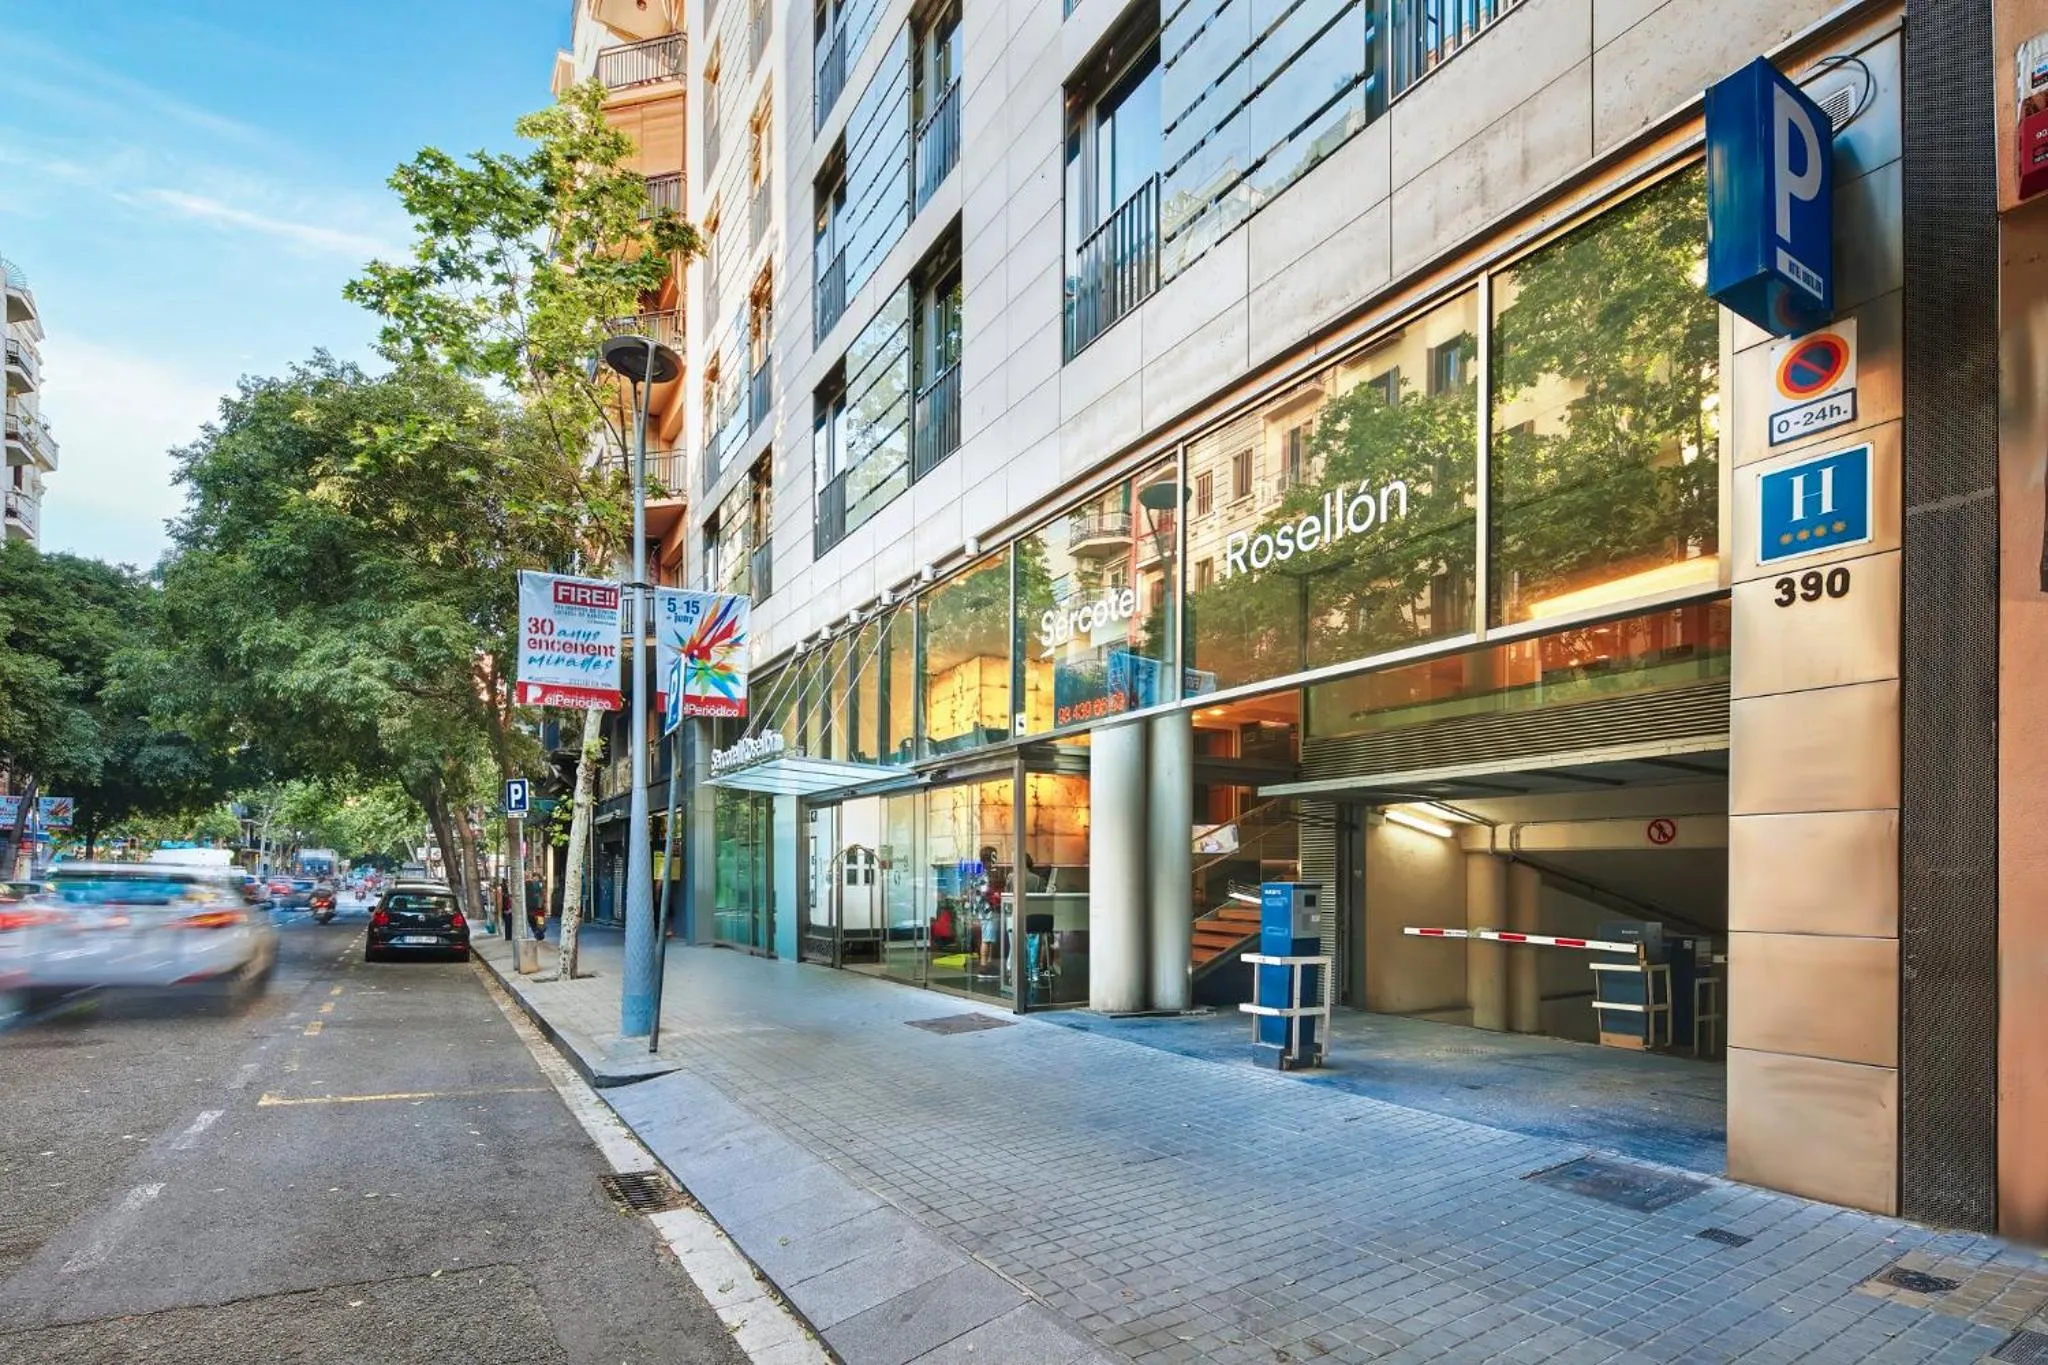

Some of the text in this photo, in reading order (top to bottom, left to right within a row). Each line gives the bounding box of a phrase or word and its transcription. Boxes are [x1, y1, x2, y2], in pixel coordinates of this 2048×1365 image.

[1773, 82, 1823, 243] P
[1777, 404, 1849, 435] 0-24h.
[1788, 465, 1839, 522] H
[1226, 479, 1408, 579] Rosellón
[557, 586, 615, 606] FIRE!!
[1774, 567, 1850, 608] 390
[667, 597, 700, 615] 5 15
[674, 613, 694, 625] juny
[1039, 581, 1141, 647] Sercotel
[527, 616, 554, 637] 30
[527, 637, 616, 658] encenent
[510, 783, 523, 809] P
